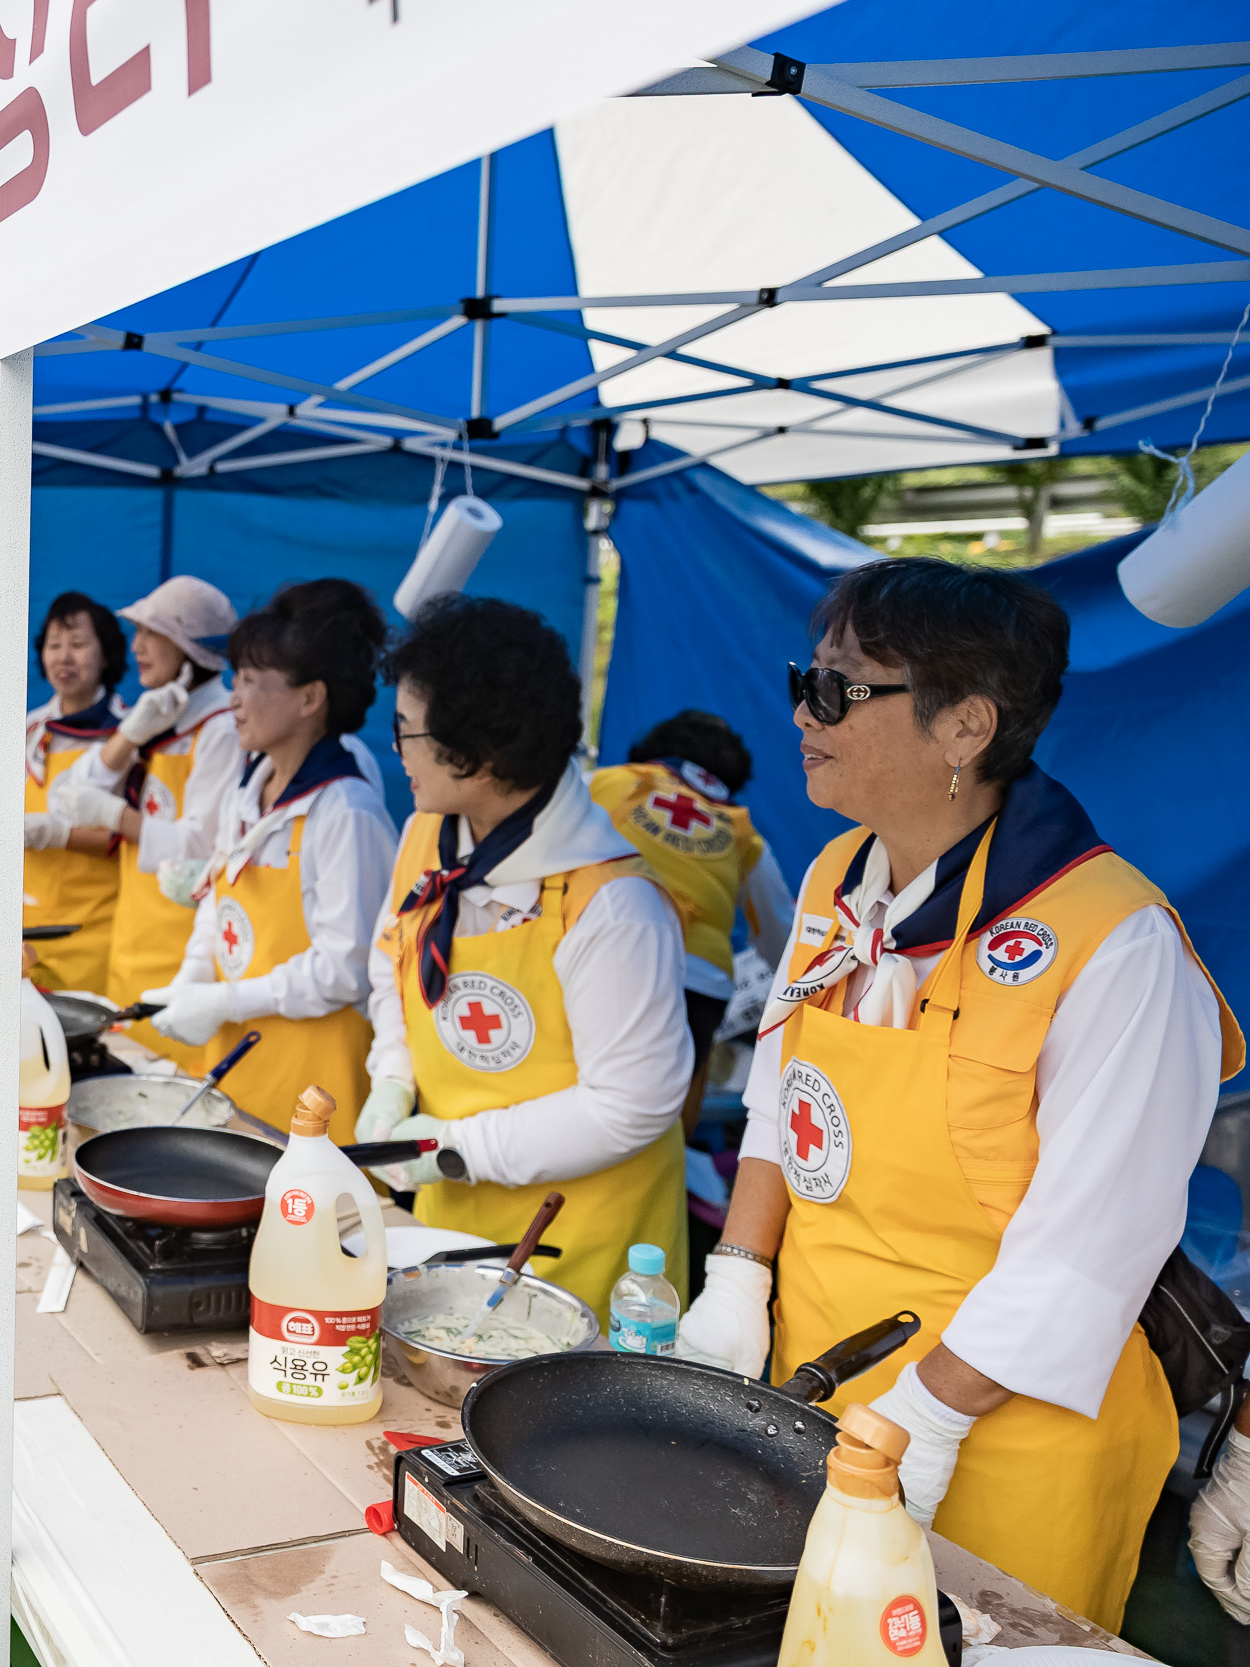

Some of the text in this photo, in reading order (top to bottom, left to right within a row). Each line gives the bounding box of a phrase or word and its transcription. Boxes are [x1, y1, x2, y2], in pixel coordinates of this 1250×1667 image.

[988, 921, 1054, 949] KOREAN RED CROSS
[462, 980, 488, 992] RED
[490, 986, 523, 1020] CROSS
[797, 1070, 821, 1093] RED
[821, 1093, 844, 1150] CROSS
[287, 1198, 308, 1217] 1등
[288, 1321, 314, 1335] 해표
[270, 1355, 330, 1383] 식용유
